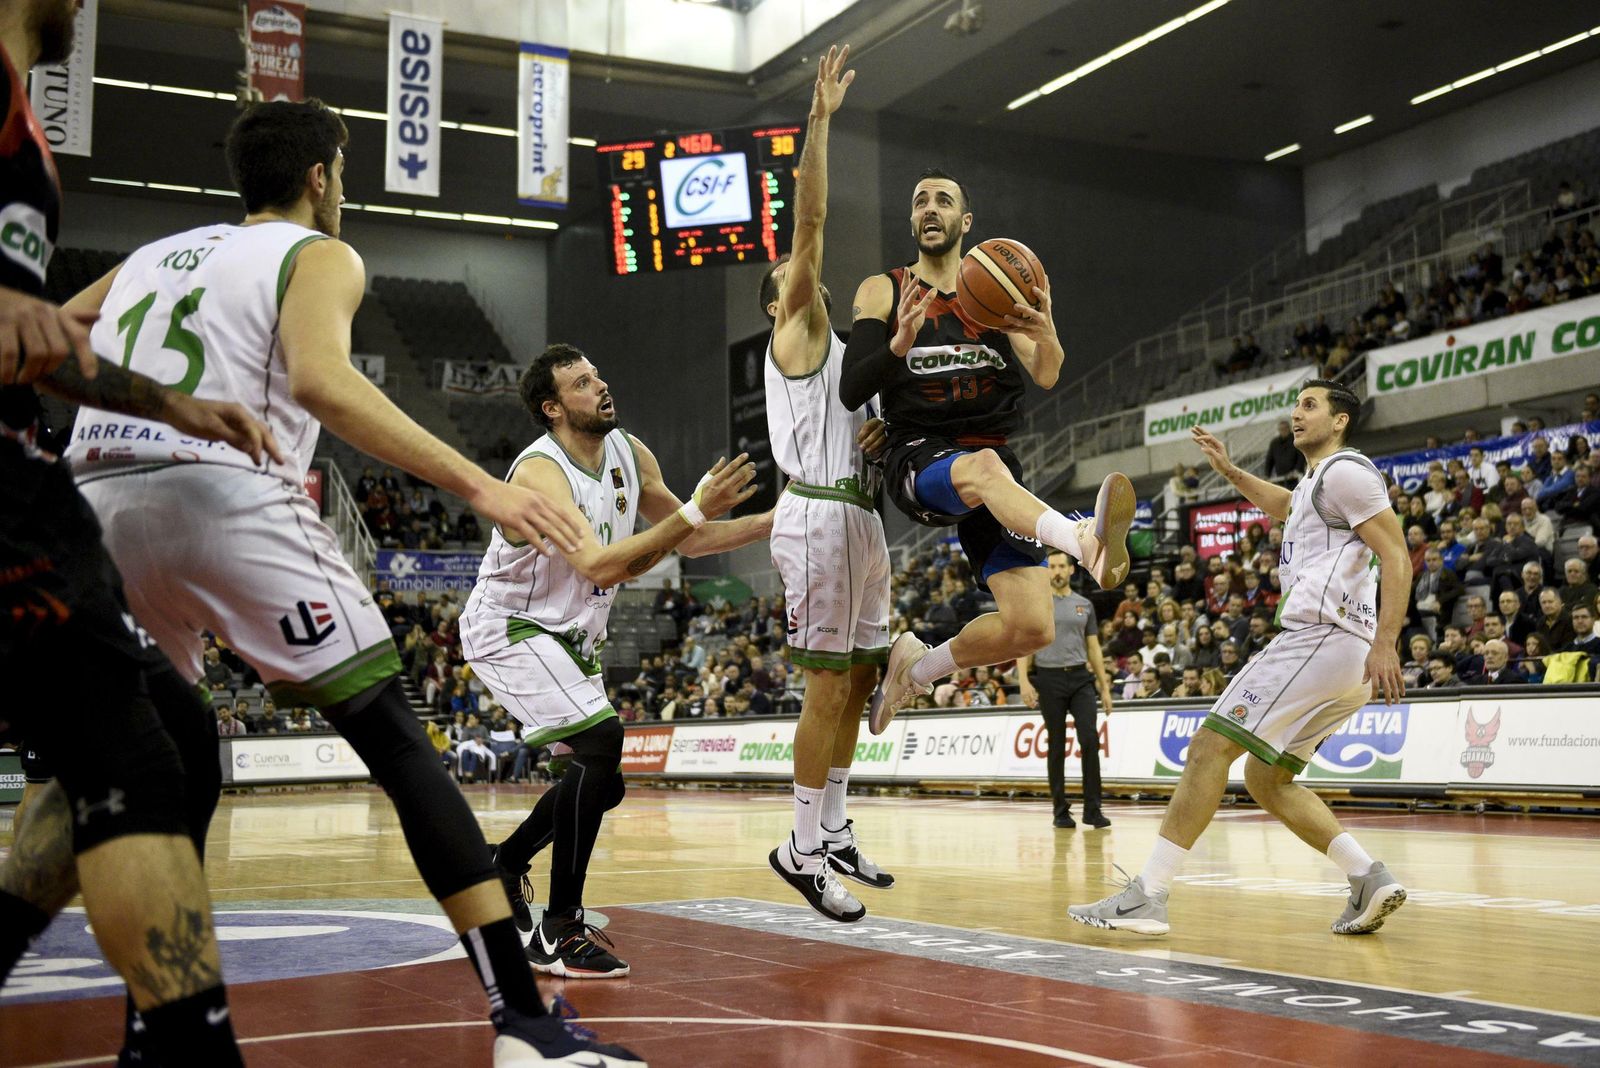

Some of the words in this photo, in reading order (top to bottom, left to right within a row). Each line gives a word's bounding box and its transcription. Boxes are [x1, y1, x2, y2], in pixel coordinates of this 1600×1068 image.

[399, 29, 431, 147] asisa
[157, 247, 215, 271] ROSI
[992, 243, 1033, 285] molten
[117, 287, 206, 396] 15
[910, 349, 1005, 371] COVIRAN
[1376, 330, 1536, 391] COVIRAN
[951, 375, 978, 401] 13
[1148, 405, 1225, 437] COVIRAN
[1229, 386, 1300, 419] COVIRA
[1241, 689, 1262, 705] TAU
[739, 741, 795, 762] COVIRA
[925, 734, 995, 756] DEKTON
[1508, 734, 1600, 748] www.fundacion
